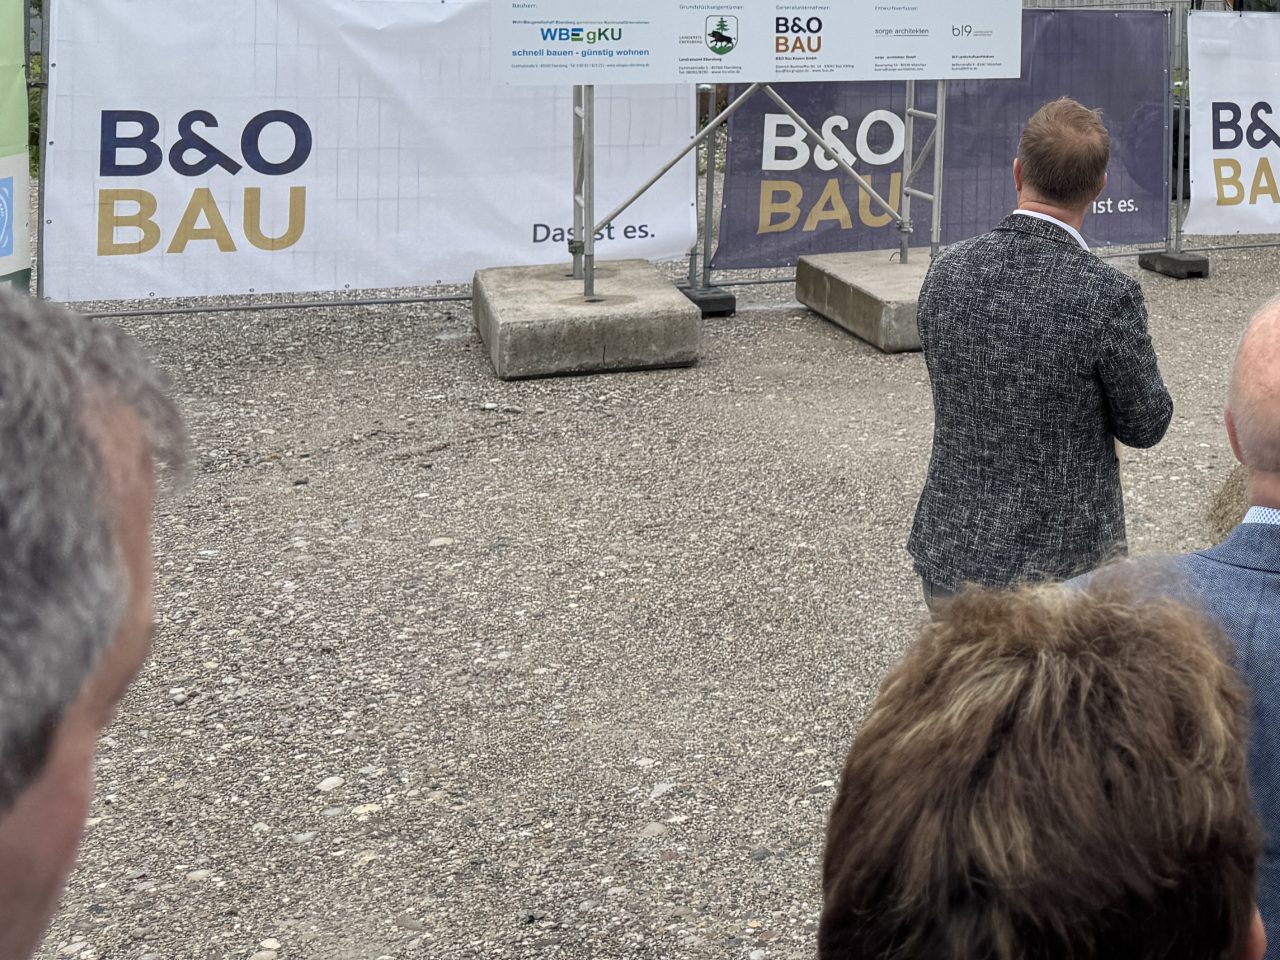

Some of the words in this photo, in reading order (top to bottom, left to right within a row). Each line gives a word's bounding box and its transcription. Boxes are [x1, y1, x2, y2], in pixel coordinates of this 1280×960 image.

[775, 16, 823, 34] B&O
[874, 28, 893, 36] sorge
[894, 27, 930, 35] architekten
[511, 48, 545, 57] schnell
[546, 48, 574, 57] bauen
[581, 48, 614, 58] günstig
[615, 48, 650, 56] wohnen
[775, 35, 822, 53] BAU
[100, 109, 313, 177] B&O
[761, 109, 906, 171] B&O
[756, 171, 902, 236] BAU
[1117, 198, 1139, 213] es.
[97, 186, 307, 257] BAU
[623, 223, 656, 240] es.
